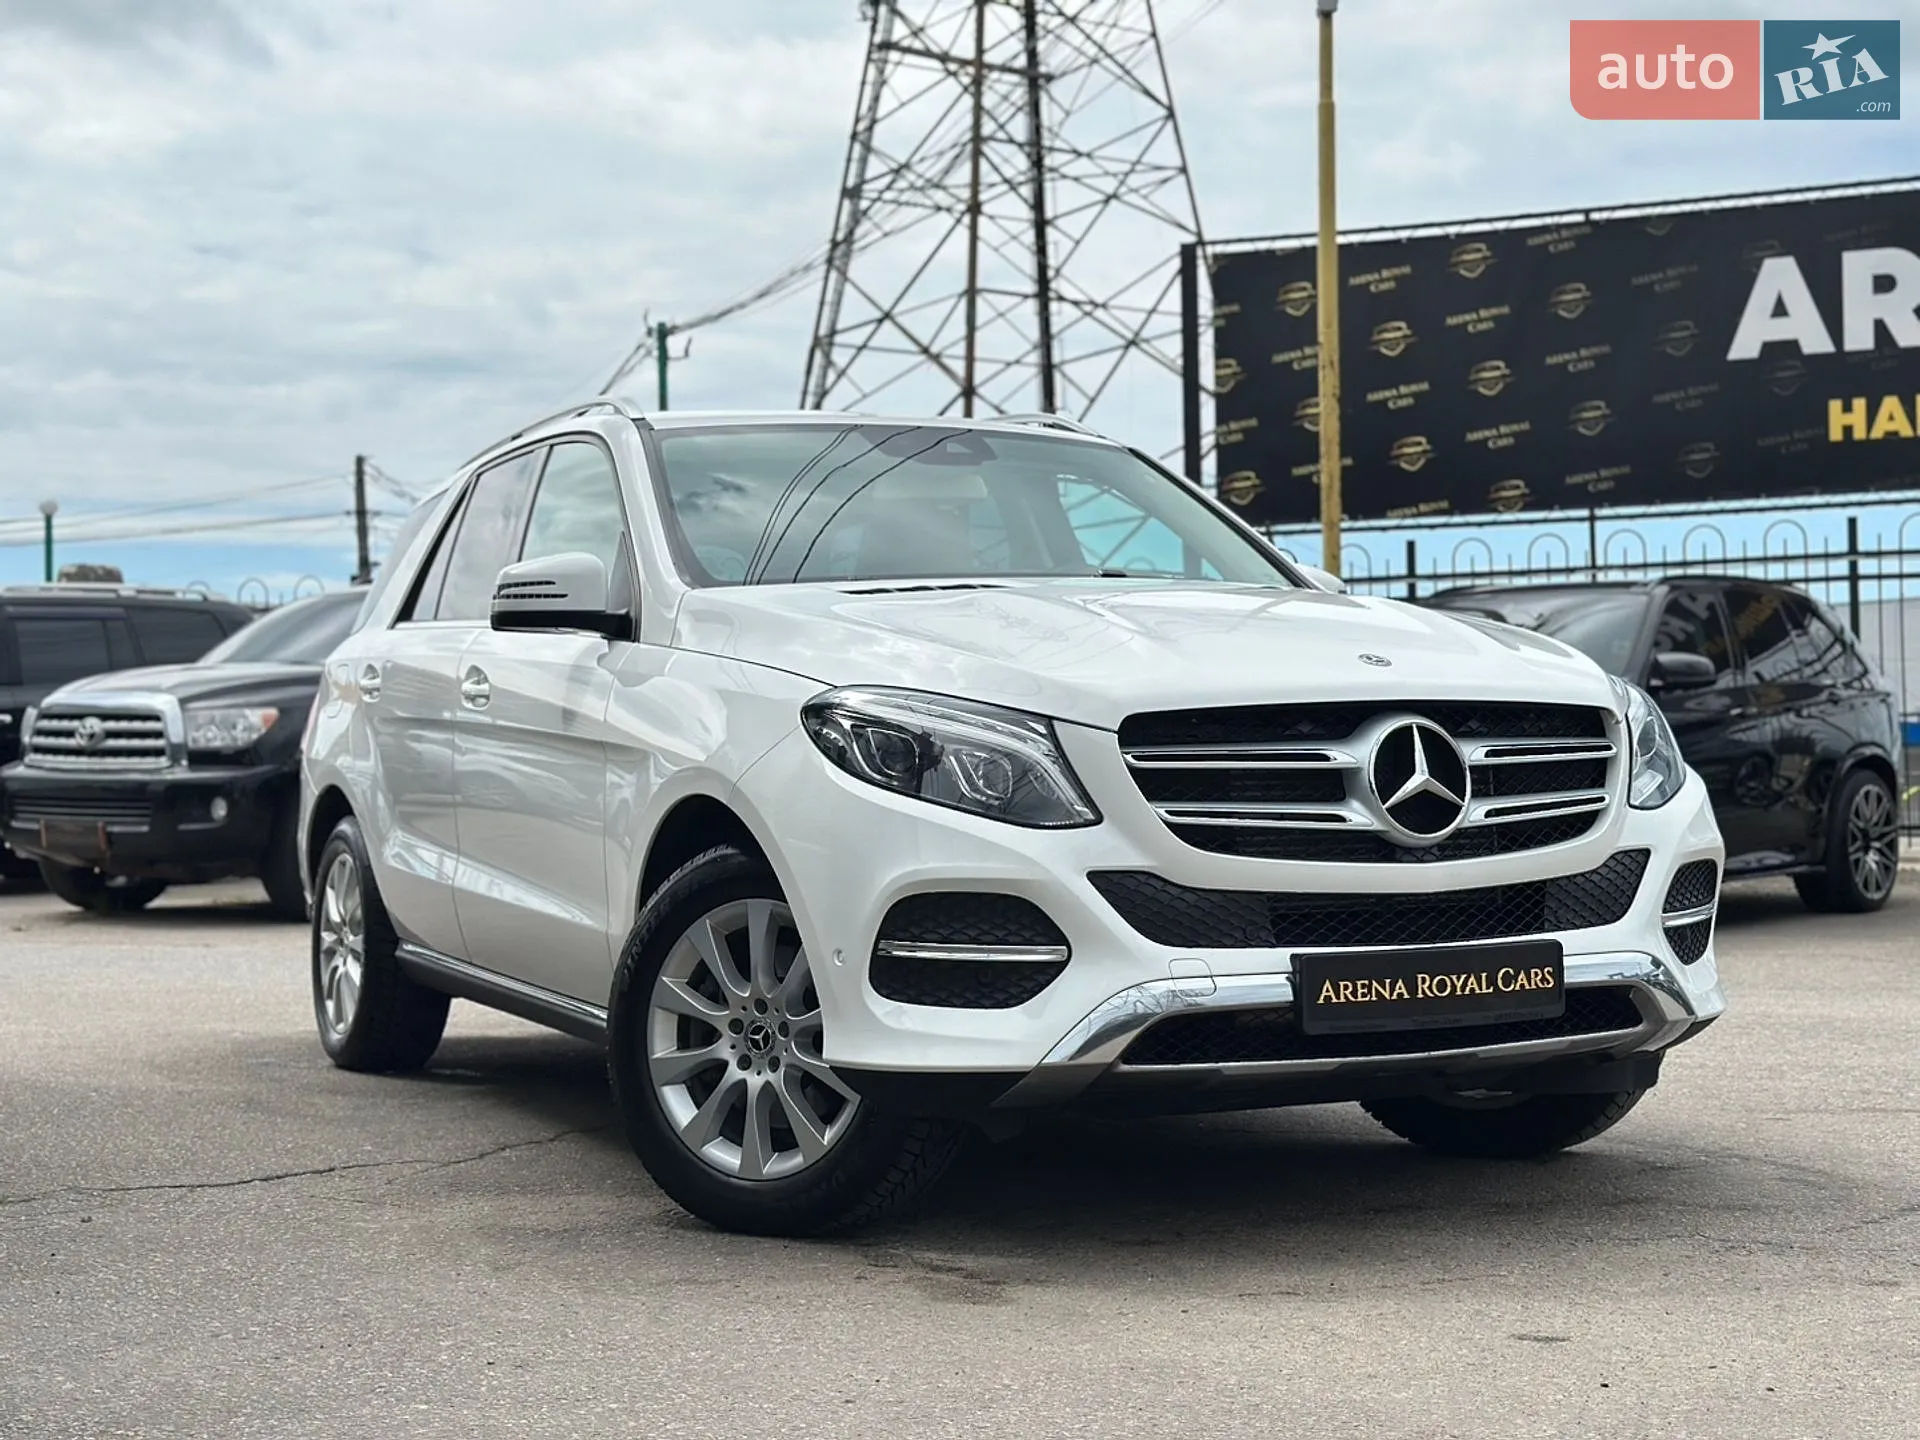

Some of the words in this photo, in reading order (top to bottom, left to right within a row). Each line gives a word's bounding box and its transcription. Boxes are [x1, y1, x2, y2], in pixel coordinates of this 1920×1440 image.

[1317, 979, 1410, 1005] ARENA
[1416, 972, 1494, 1000] ROYAL
[1497, 965, 1555, 993] CARS
